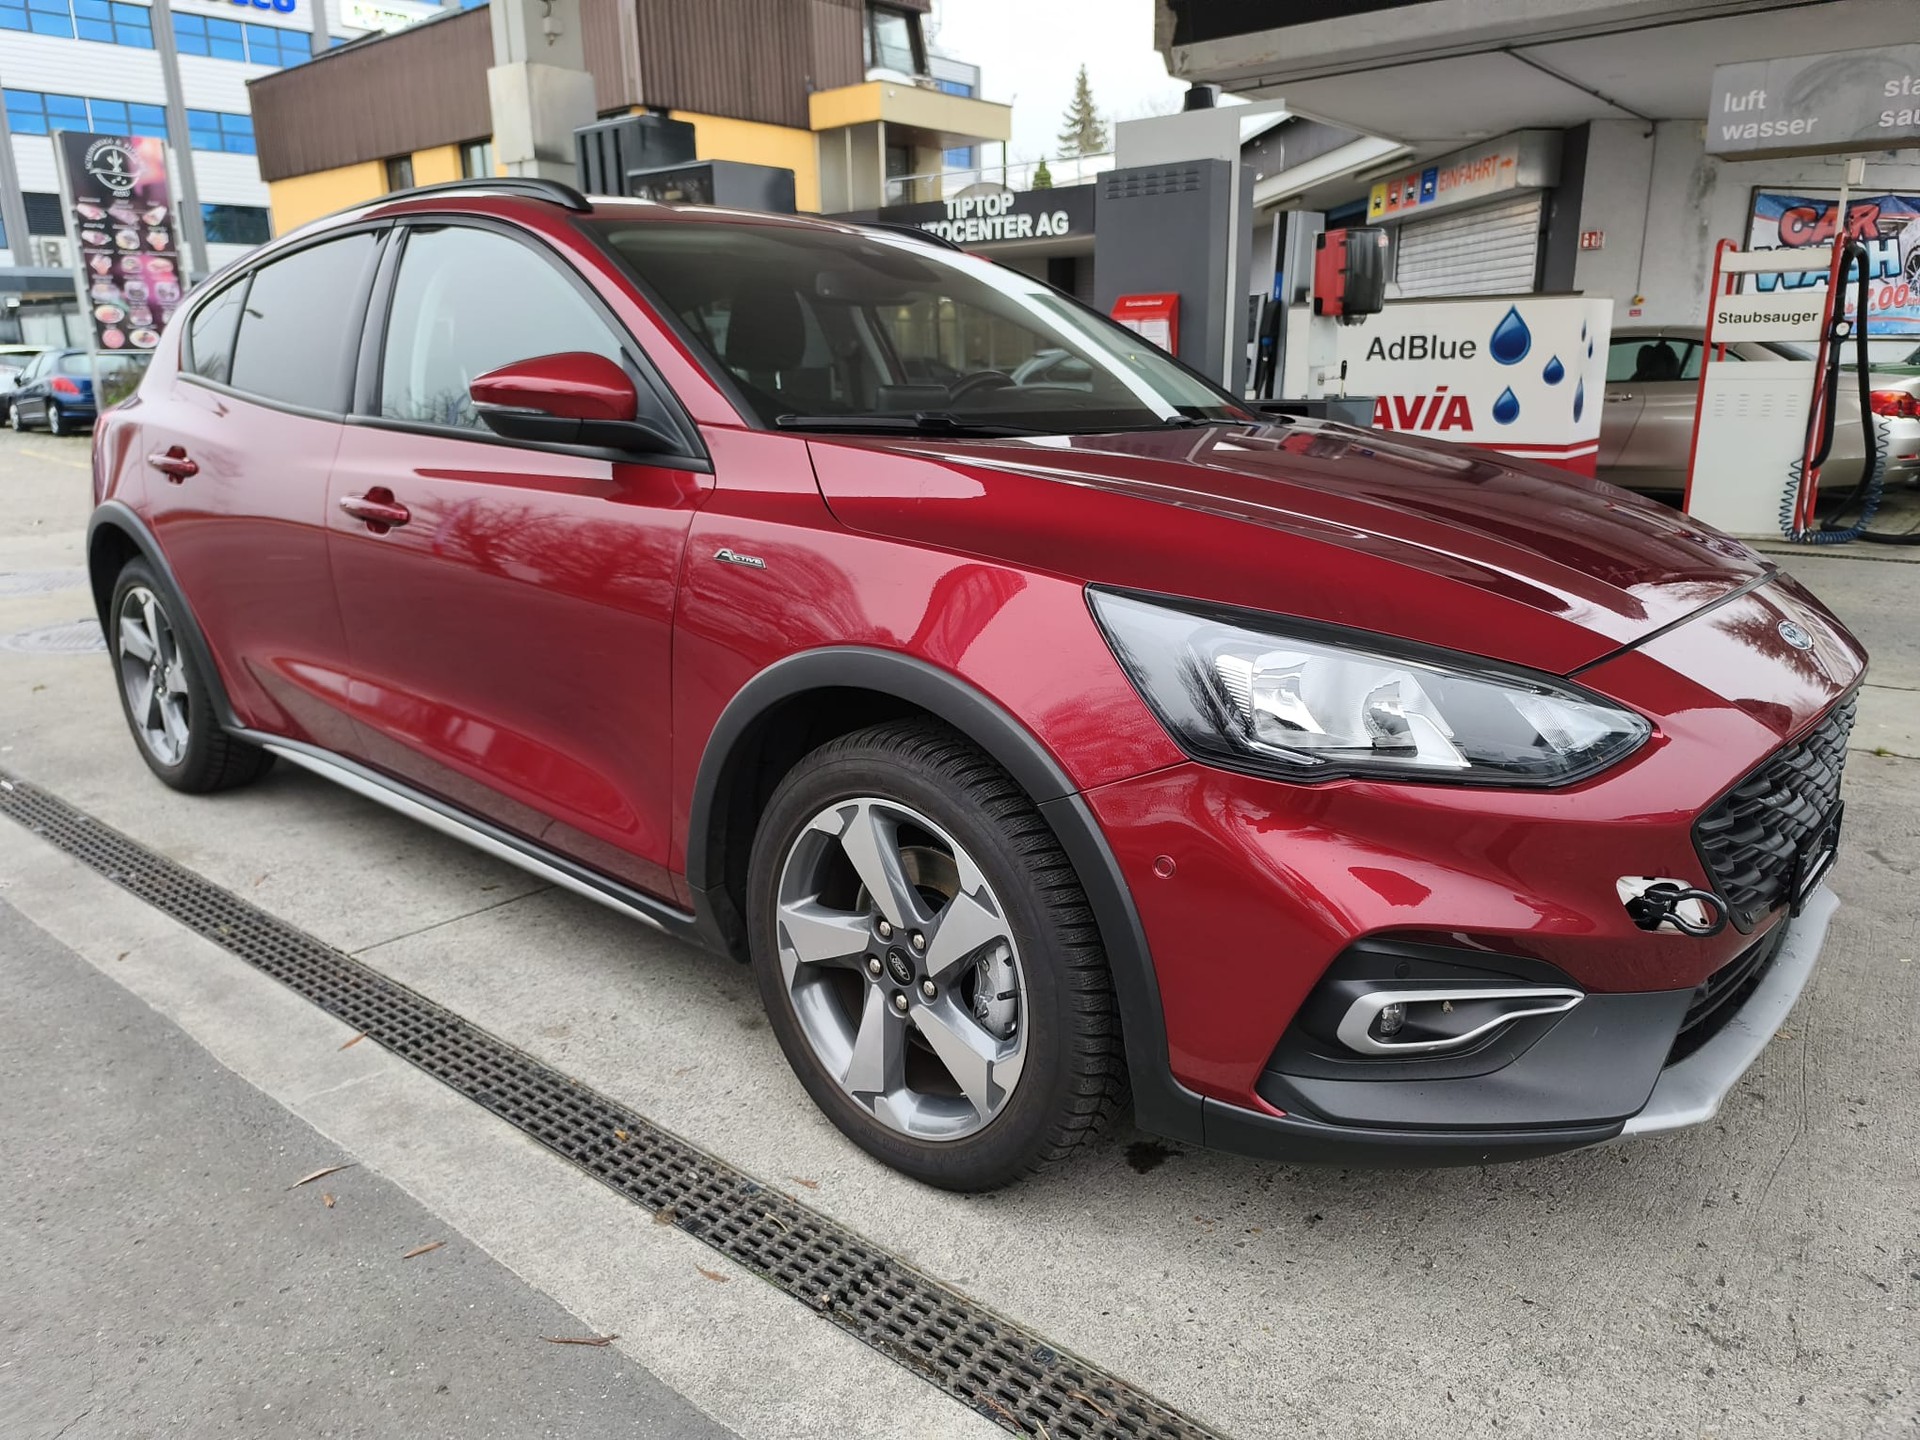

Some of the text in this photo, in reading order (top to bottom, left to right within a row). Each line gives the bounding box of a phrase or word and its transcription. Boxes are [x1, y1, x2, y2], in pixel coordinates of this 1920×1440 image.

[1724, 90, 1767, 112] luft
[1722, 117, 1818, 140] wasser
[1439, 155, 1499, 192] EINFAHRT
[944, 192, 1014, 219] TIPTOP
[1035, 210, 1069, 236] AG
[1778, 205, 1881, 247] CAR
[1718, 312, 1818, 325] Staubsauger
[1366, 335, 1477, 361] AdBlue
